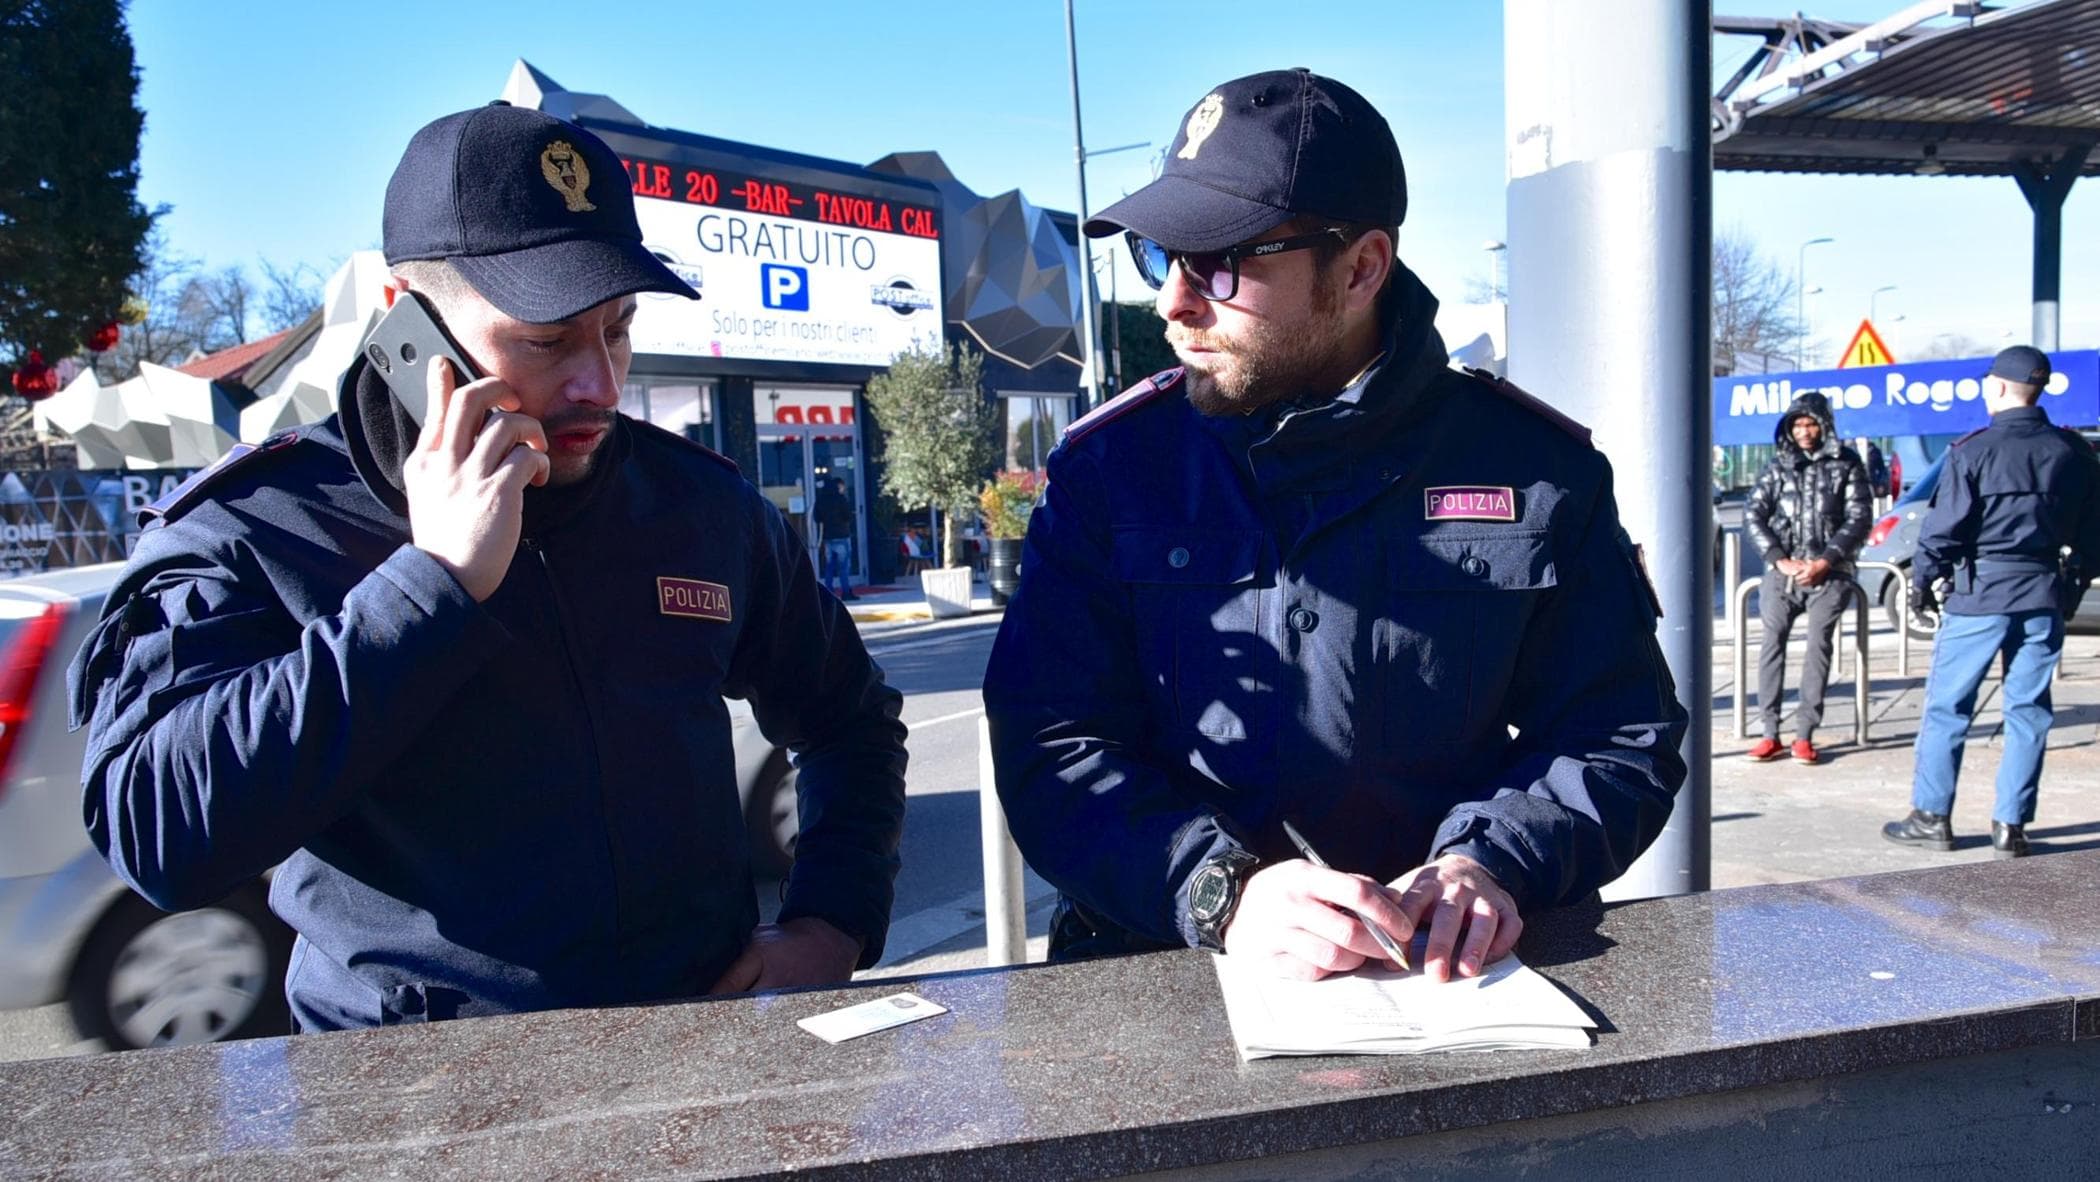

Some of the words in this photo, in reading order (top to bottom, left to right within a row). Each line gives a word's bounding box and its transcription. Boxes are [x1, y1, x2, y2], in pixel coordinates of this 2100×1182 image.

[685, 171, 719, 205] 20
[815, 192, 893, 232] TAVOLA
[901, 207, 939, 239] CAL
[697, 214, 876, 271] GRATUITO
[712, 309, 747, 335] Solo
[753, 318, 778, 342] per
[1430, 493, 1508, 512] POLIZIA
[663, 586, 727, 612] POLIZIA
